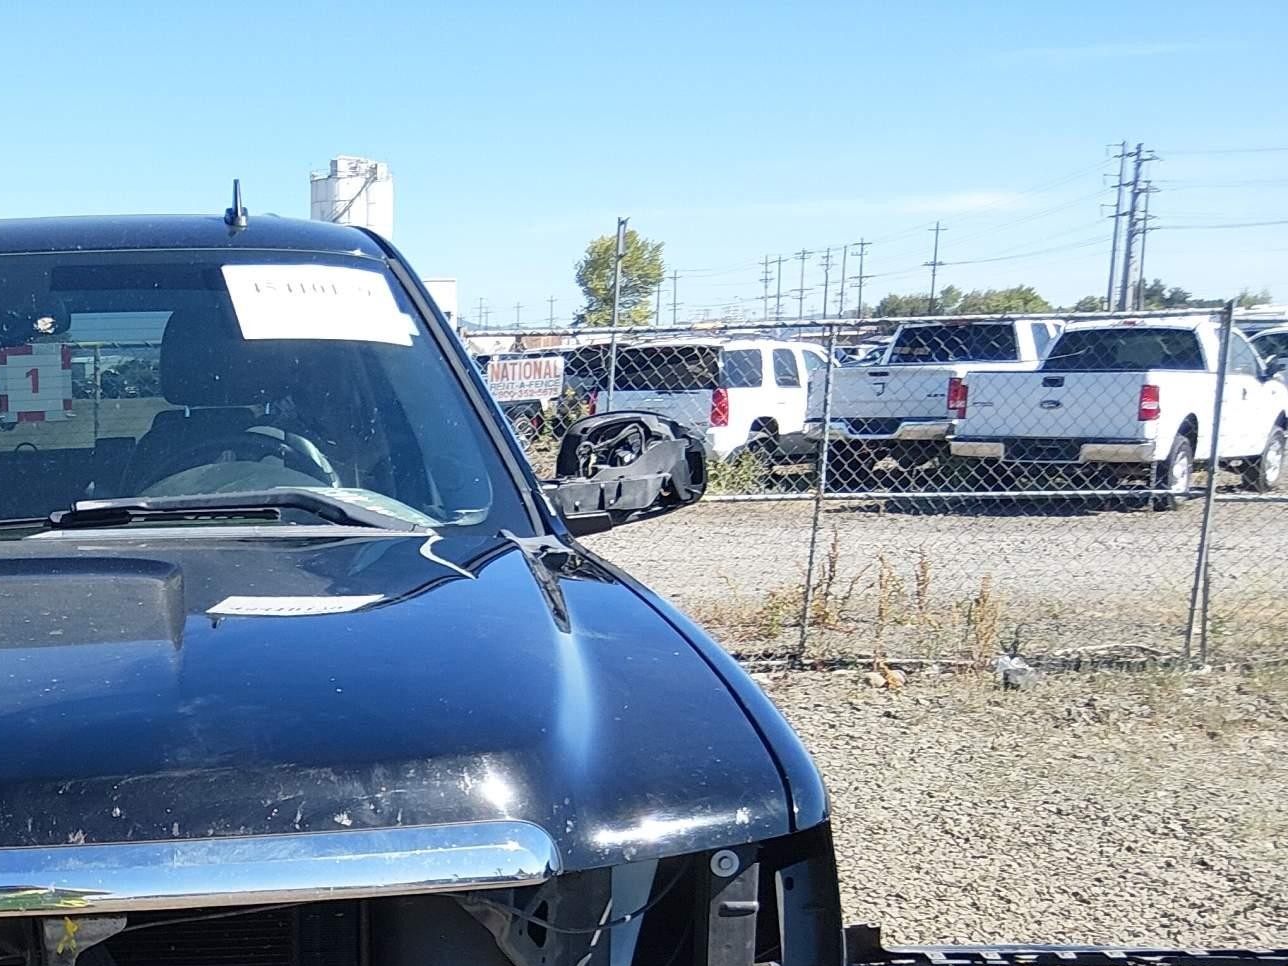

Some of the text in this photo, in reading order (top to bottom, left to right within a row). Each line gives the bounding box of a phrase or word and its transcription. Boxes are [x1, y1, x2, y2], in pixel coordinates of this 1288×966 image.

[25, 367, 40, 393] 1
[491, 359, 561, 382] NATIONAL
[490, 379, 561, 391] RENT-A-FENCE
